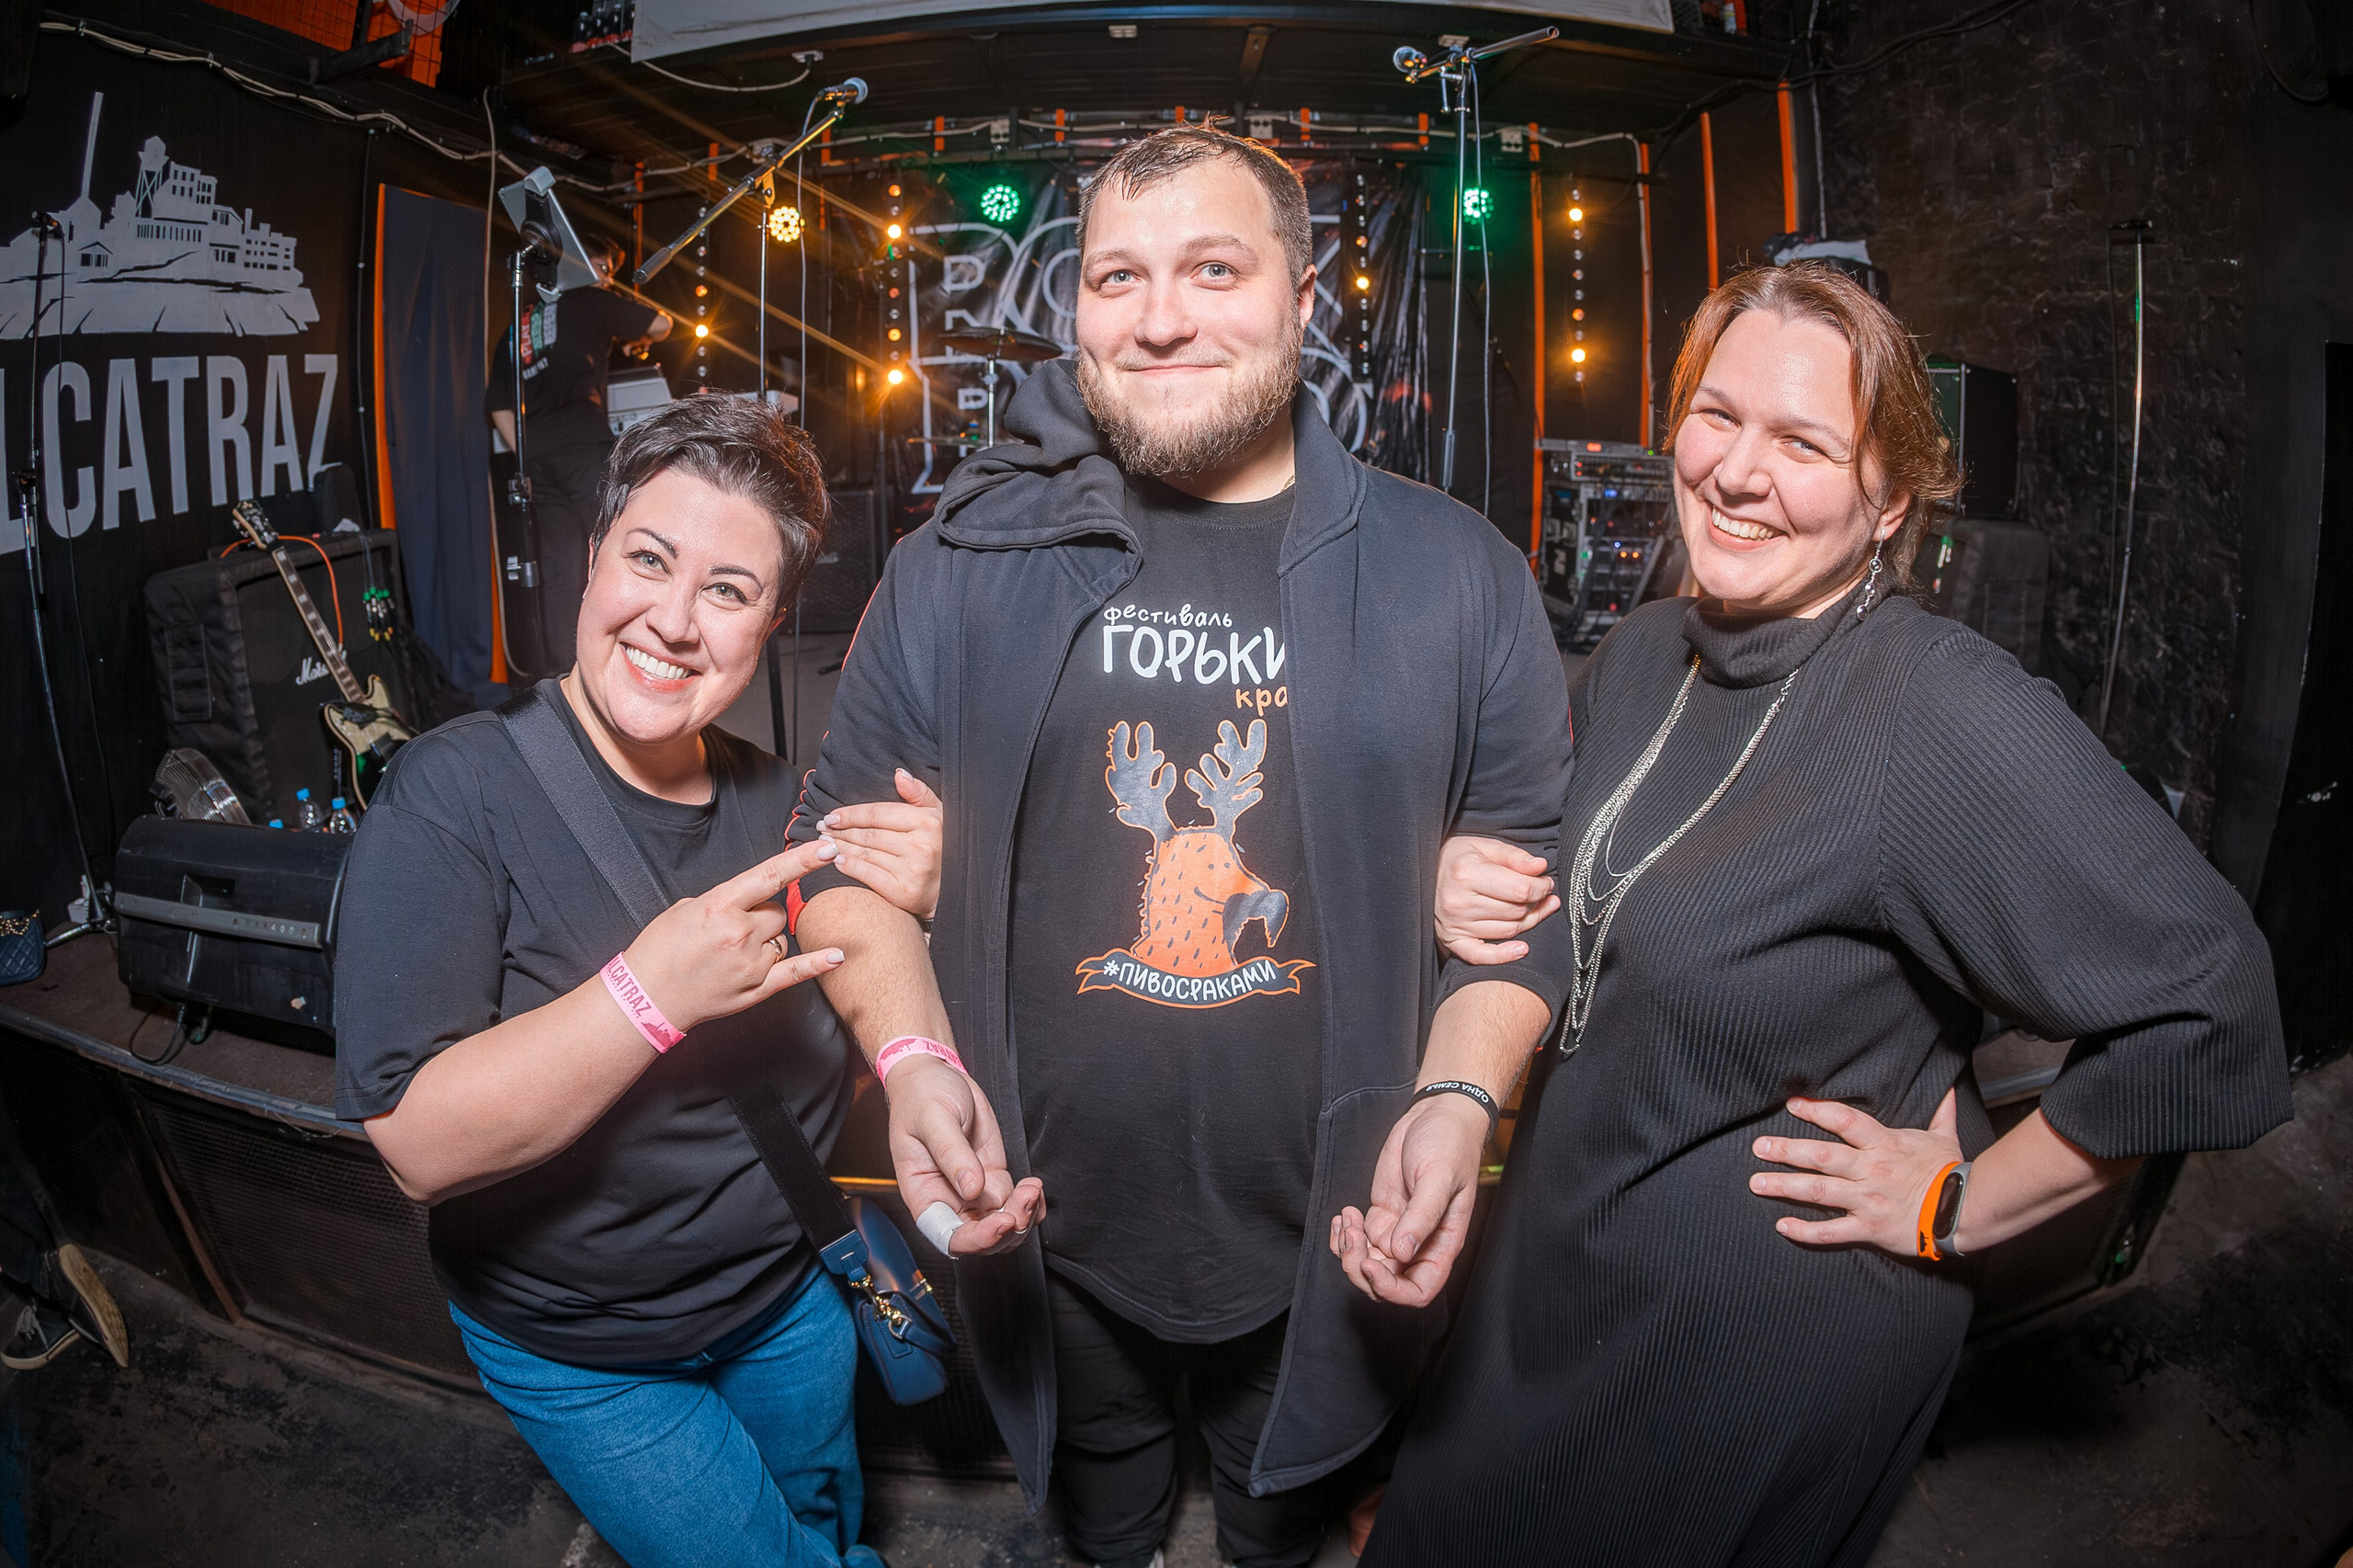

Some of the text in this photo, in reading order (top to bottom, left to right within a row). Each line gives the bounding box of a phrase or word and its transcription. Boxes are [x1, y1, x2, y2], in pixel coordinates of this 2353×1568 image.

[1103, 603, 1233, 628] фестиваль
[1103, 959, 1277, 1002] #ПИВОСРАКАМИ
[1426, 1081, 1489, 1104] ОДНА СЕМЬЯ
